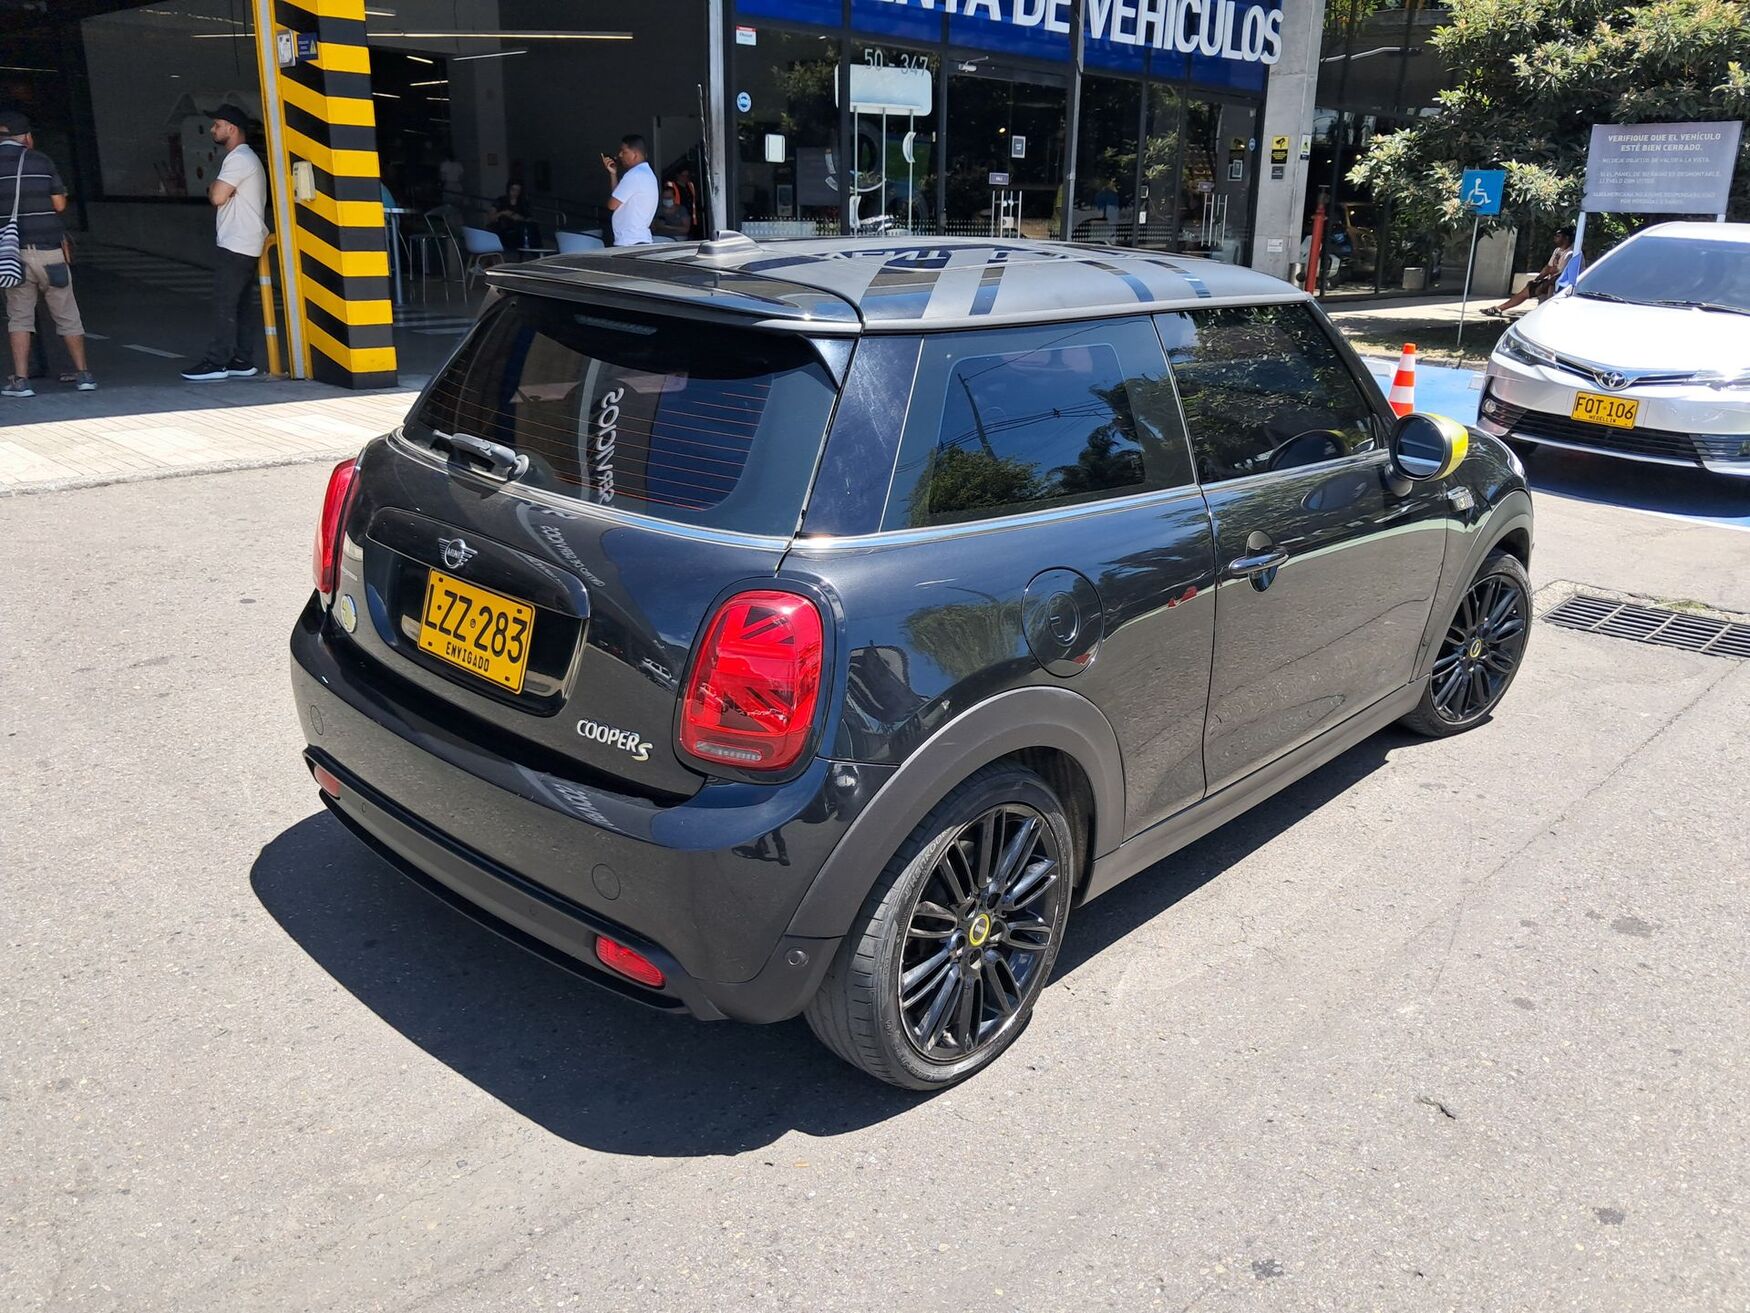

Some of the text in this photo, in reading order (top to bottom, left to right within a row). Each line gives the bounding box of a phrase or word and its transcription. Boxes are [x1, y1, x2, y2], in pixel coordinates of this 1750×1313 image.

[864, 48, 883, 72] 50
[900, 53, 928, 76] 347
[1608, 134, 1649, 142] VERIFIQUE
[1650, 134, 1667, 142] QUE
[1680, 131, 1721, 141] VEHÍCULO
[1621, 143, 1640, 151] ESTÉ
[1663, 143, 1702, 151] CERRADO.
[1575, 396, 1636, 420] FOT 106
[424, 583, 528, 664] LZZ 283
[445, 641, 490, 672] ENVIGADO
[576, 718, 640, 753] COOPER
